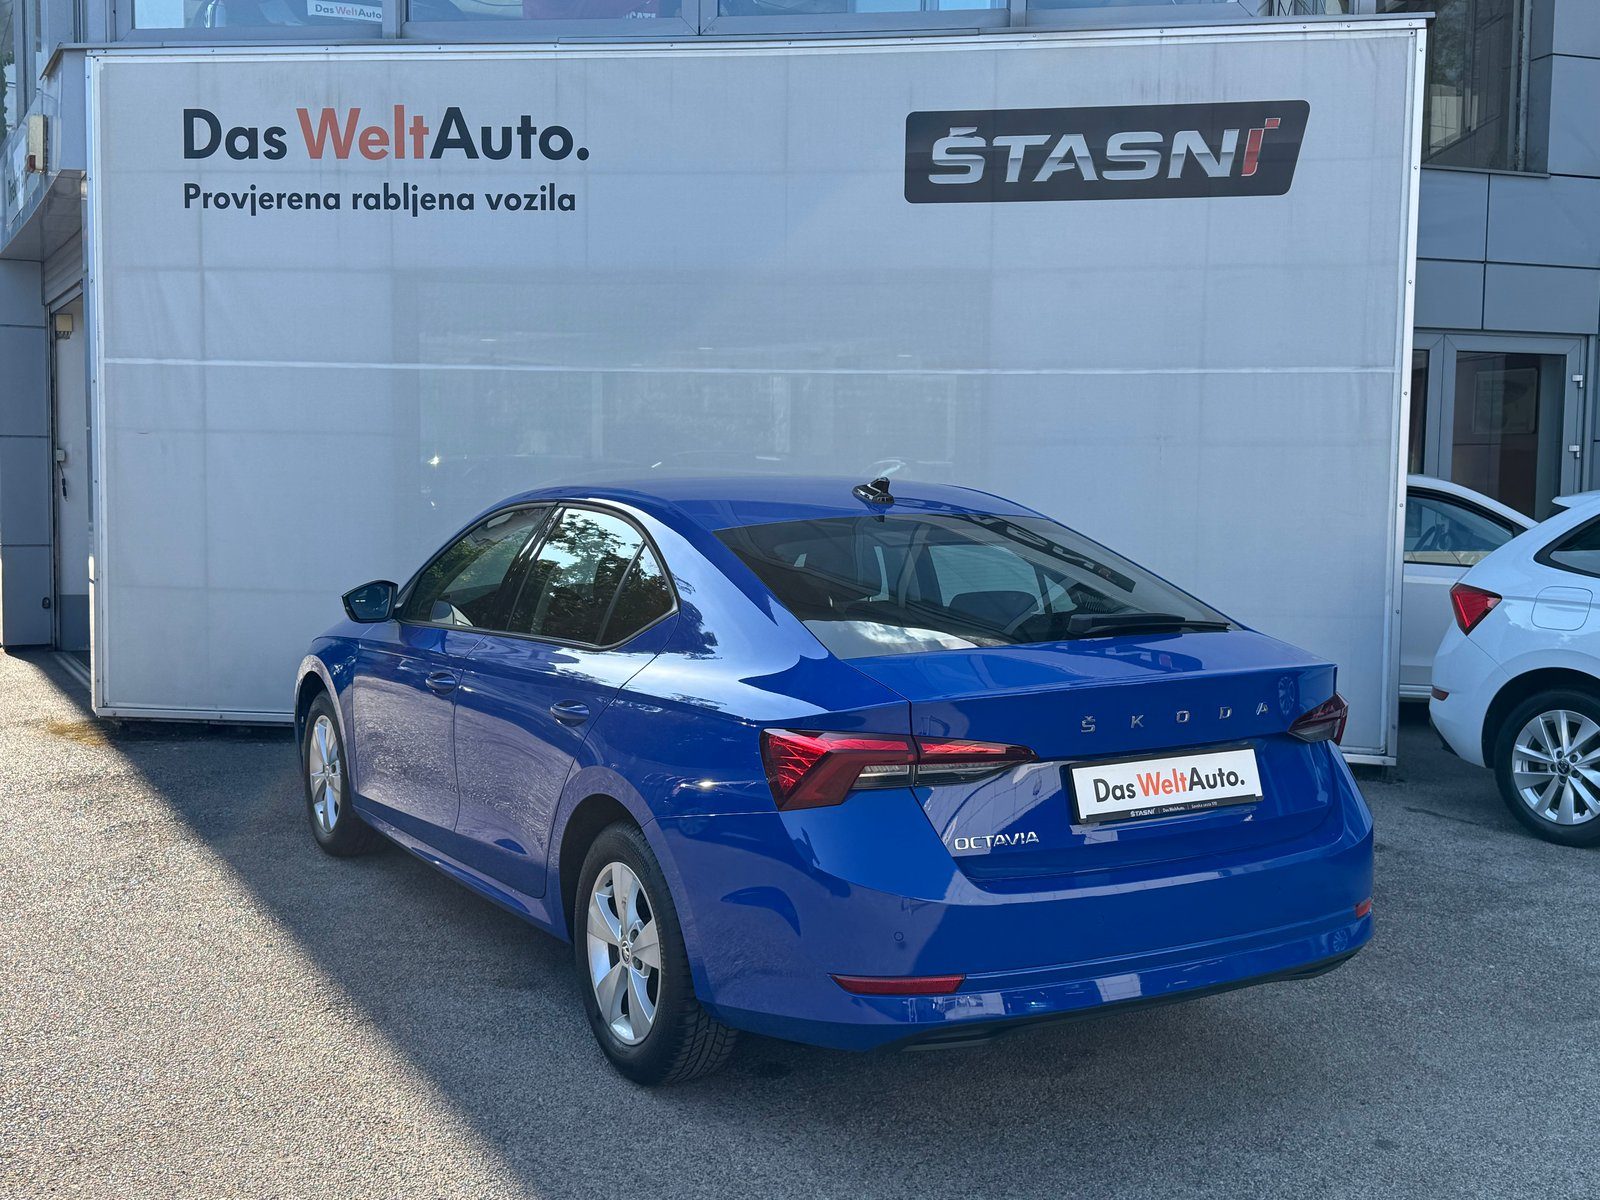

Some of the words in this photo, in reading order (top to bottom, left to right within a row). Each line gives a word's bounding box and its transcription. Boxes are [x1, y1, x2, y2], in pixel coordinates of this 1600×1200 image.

[183, 108, 288, 160] Das
[183, 182, 341, 216] Provjerena
[352, 182, 475, 217] rabljena
[485, 182, 576, 211] vozila
[1080, 702, 1269, 733] ŠKODA
[1093, 778, 1136, 803] Das
[954, 831, 1040, 850] OCTAVIA
